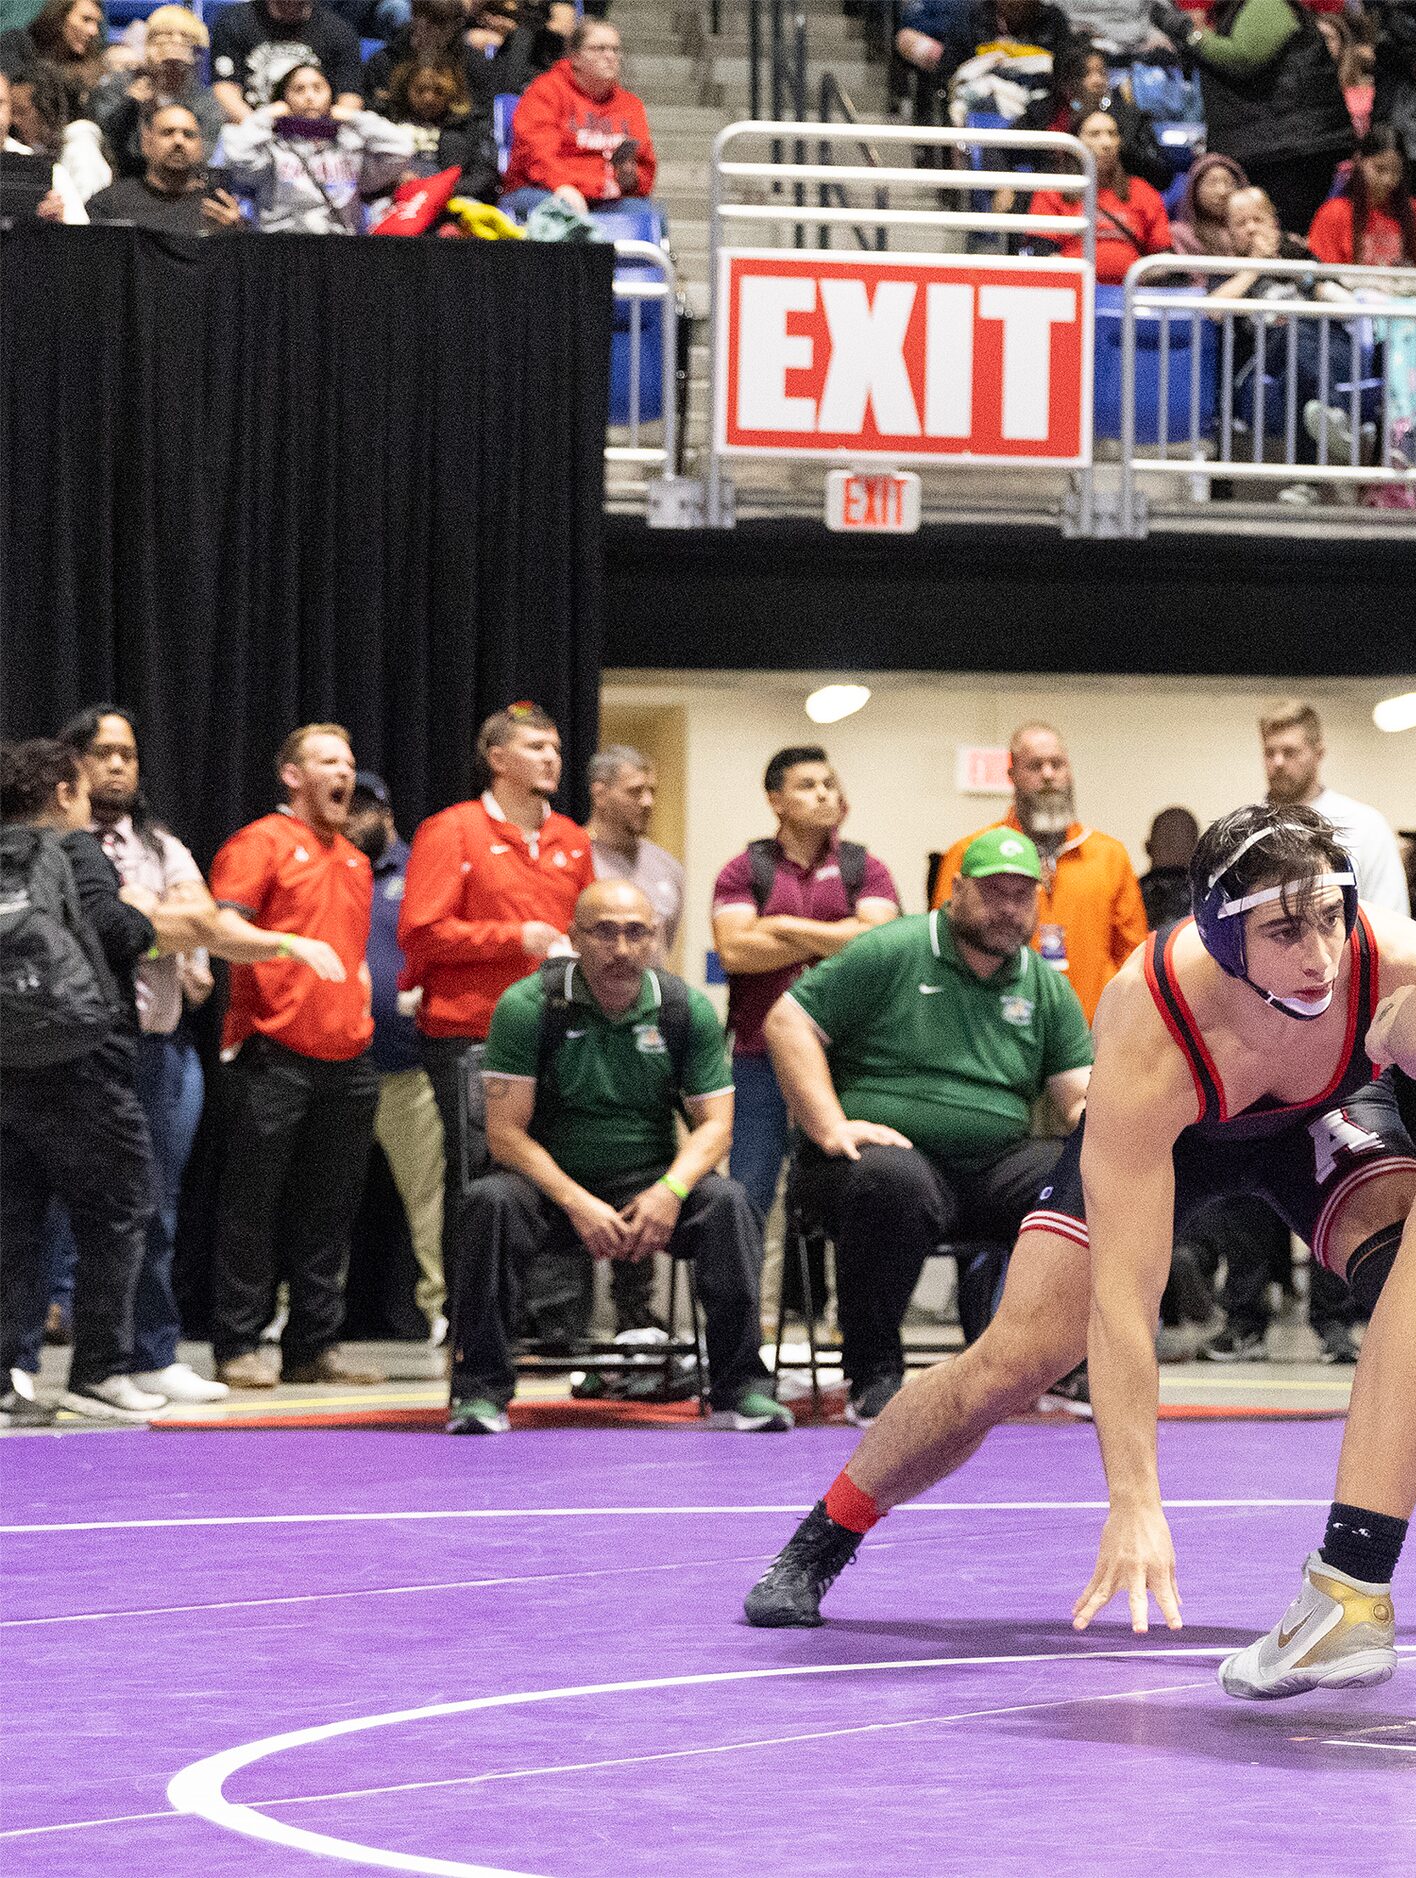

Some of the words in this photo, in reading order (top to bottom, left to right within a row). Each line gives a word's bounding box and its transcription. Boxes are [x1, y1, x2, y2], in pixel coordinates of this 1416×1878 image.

[737, 275, 1076, 441] EXIT
[842, 477, 907, 526] EXIT
[1307, 1108, 1383, 1185] A
